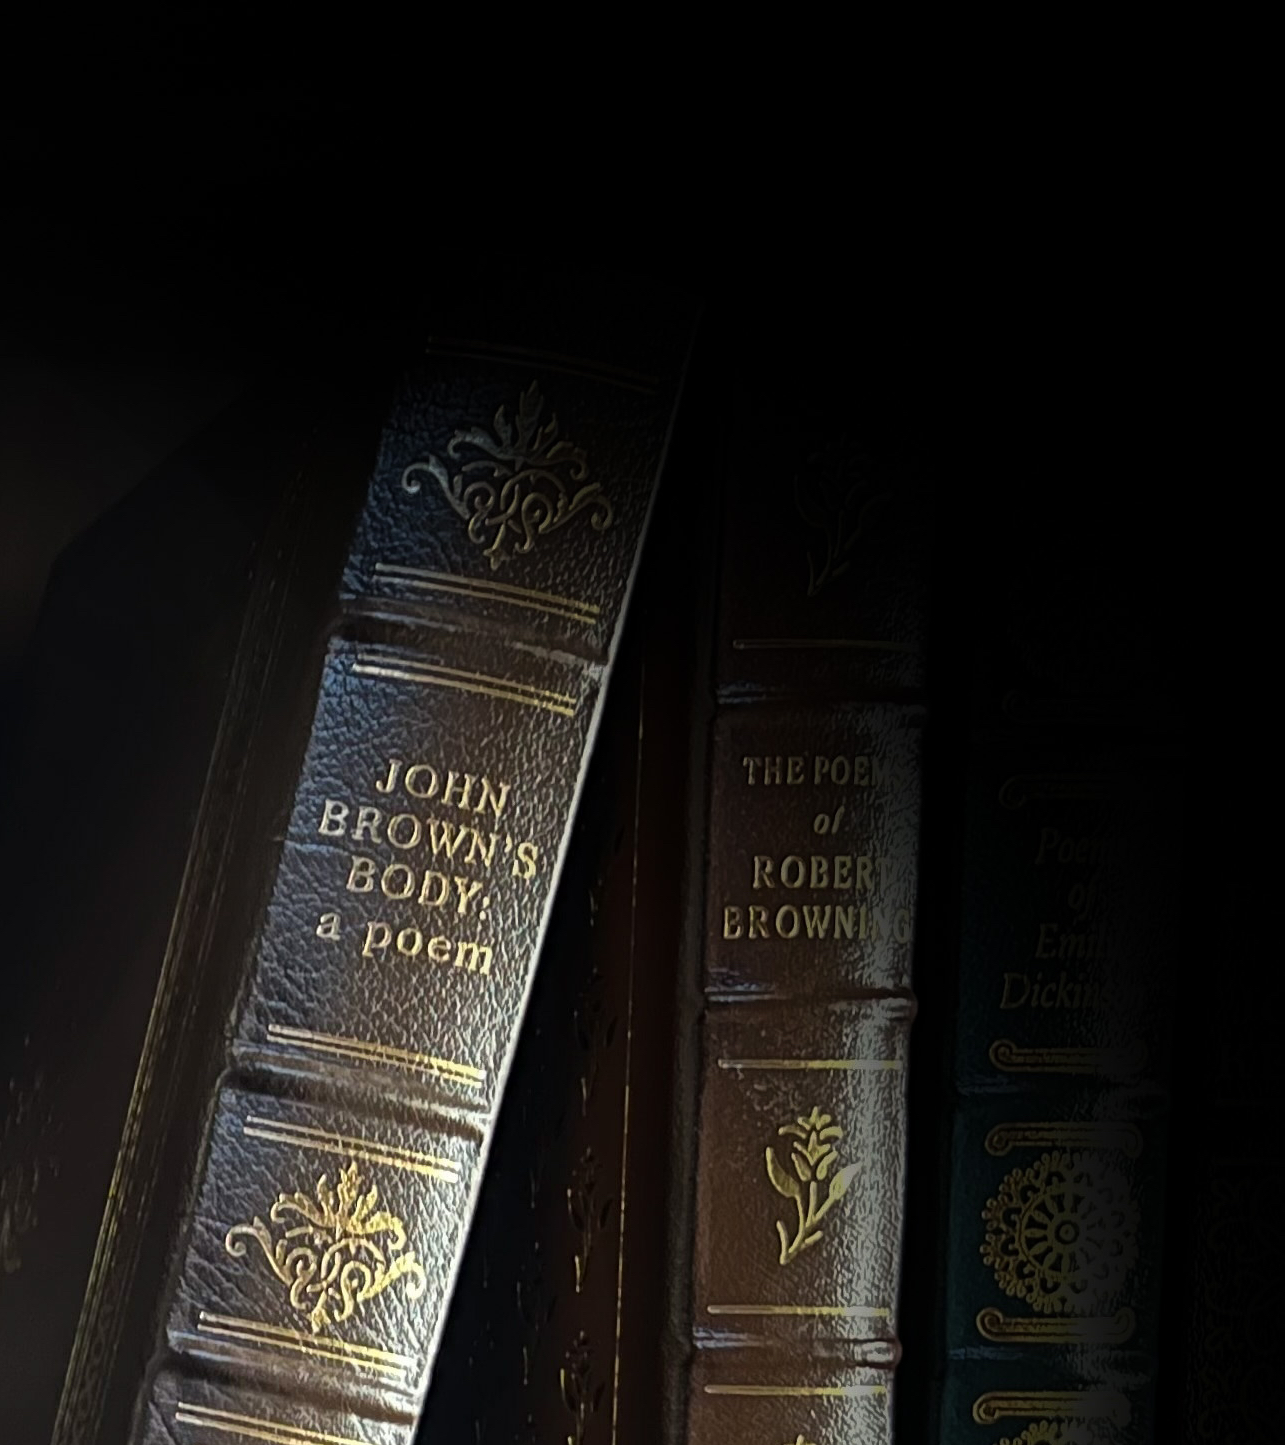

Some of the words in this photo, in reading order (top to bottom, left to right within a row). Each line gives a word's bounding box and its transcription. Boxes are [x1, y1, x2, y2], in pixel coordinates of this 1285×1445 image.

[375, 758, 510, 818] JOHN
[742, 755, 806, 787] THE
[318, 798, 539, 881] BROWN'S
[813, 804, 846, 836] of
[315, 910, 343, 942] a
[362, 920, 494, 976] poem
